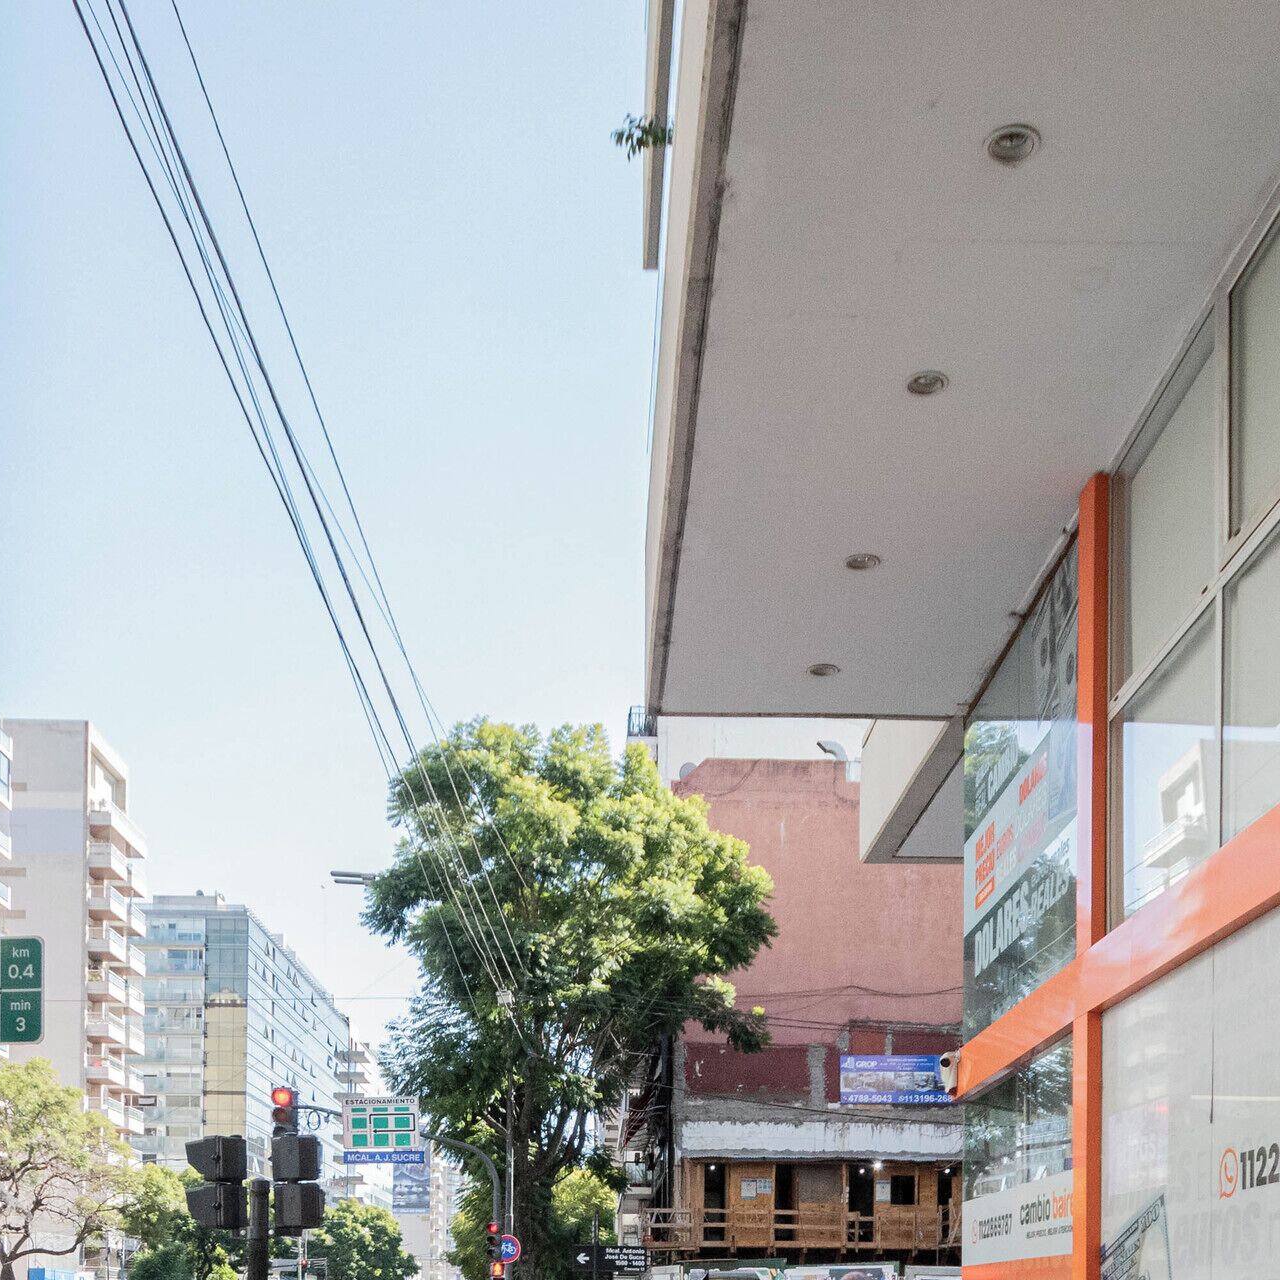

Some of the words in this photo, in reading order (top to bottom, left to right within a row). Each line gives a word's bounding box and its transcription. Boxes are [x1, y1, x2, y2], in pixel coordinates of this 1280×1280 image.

[974, 881, 1029, 979] DOLARES
[12, 947, 30, 958] km
[8, 964, 35, 980] 0.4
[10, 999, 31, 1011] min
[15, 1017, 26, 1033] 3
[1020, 1193, 1051, 1226] cambio
